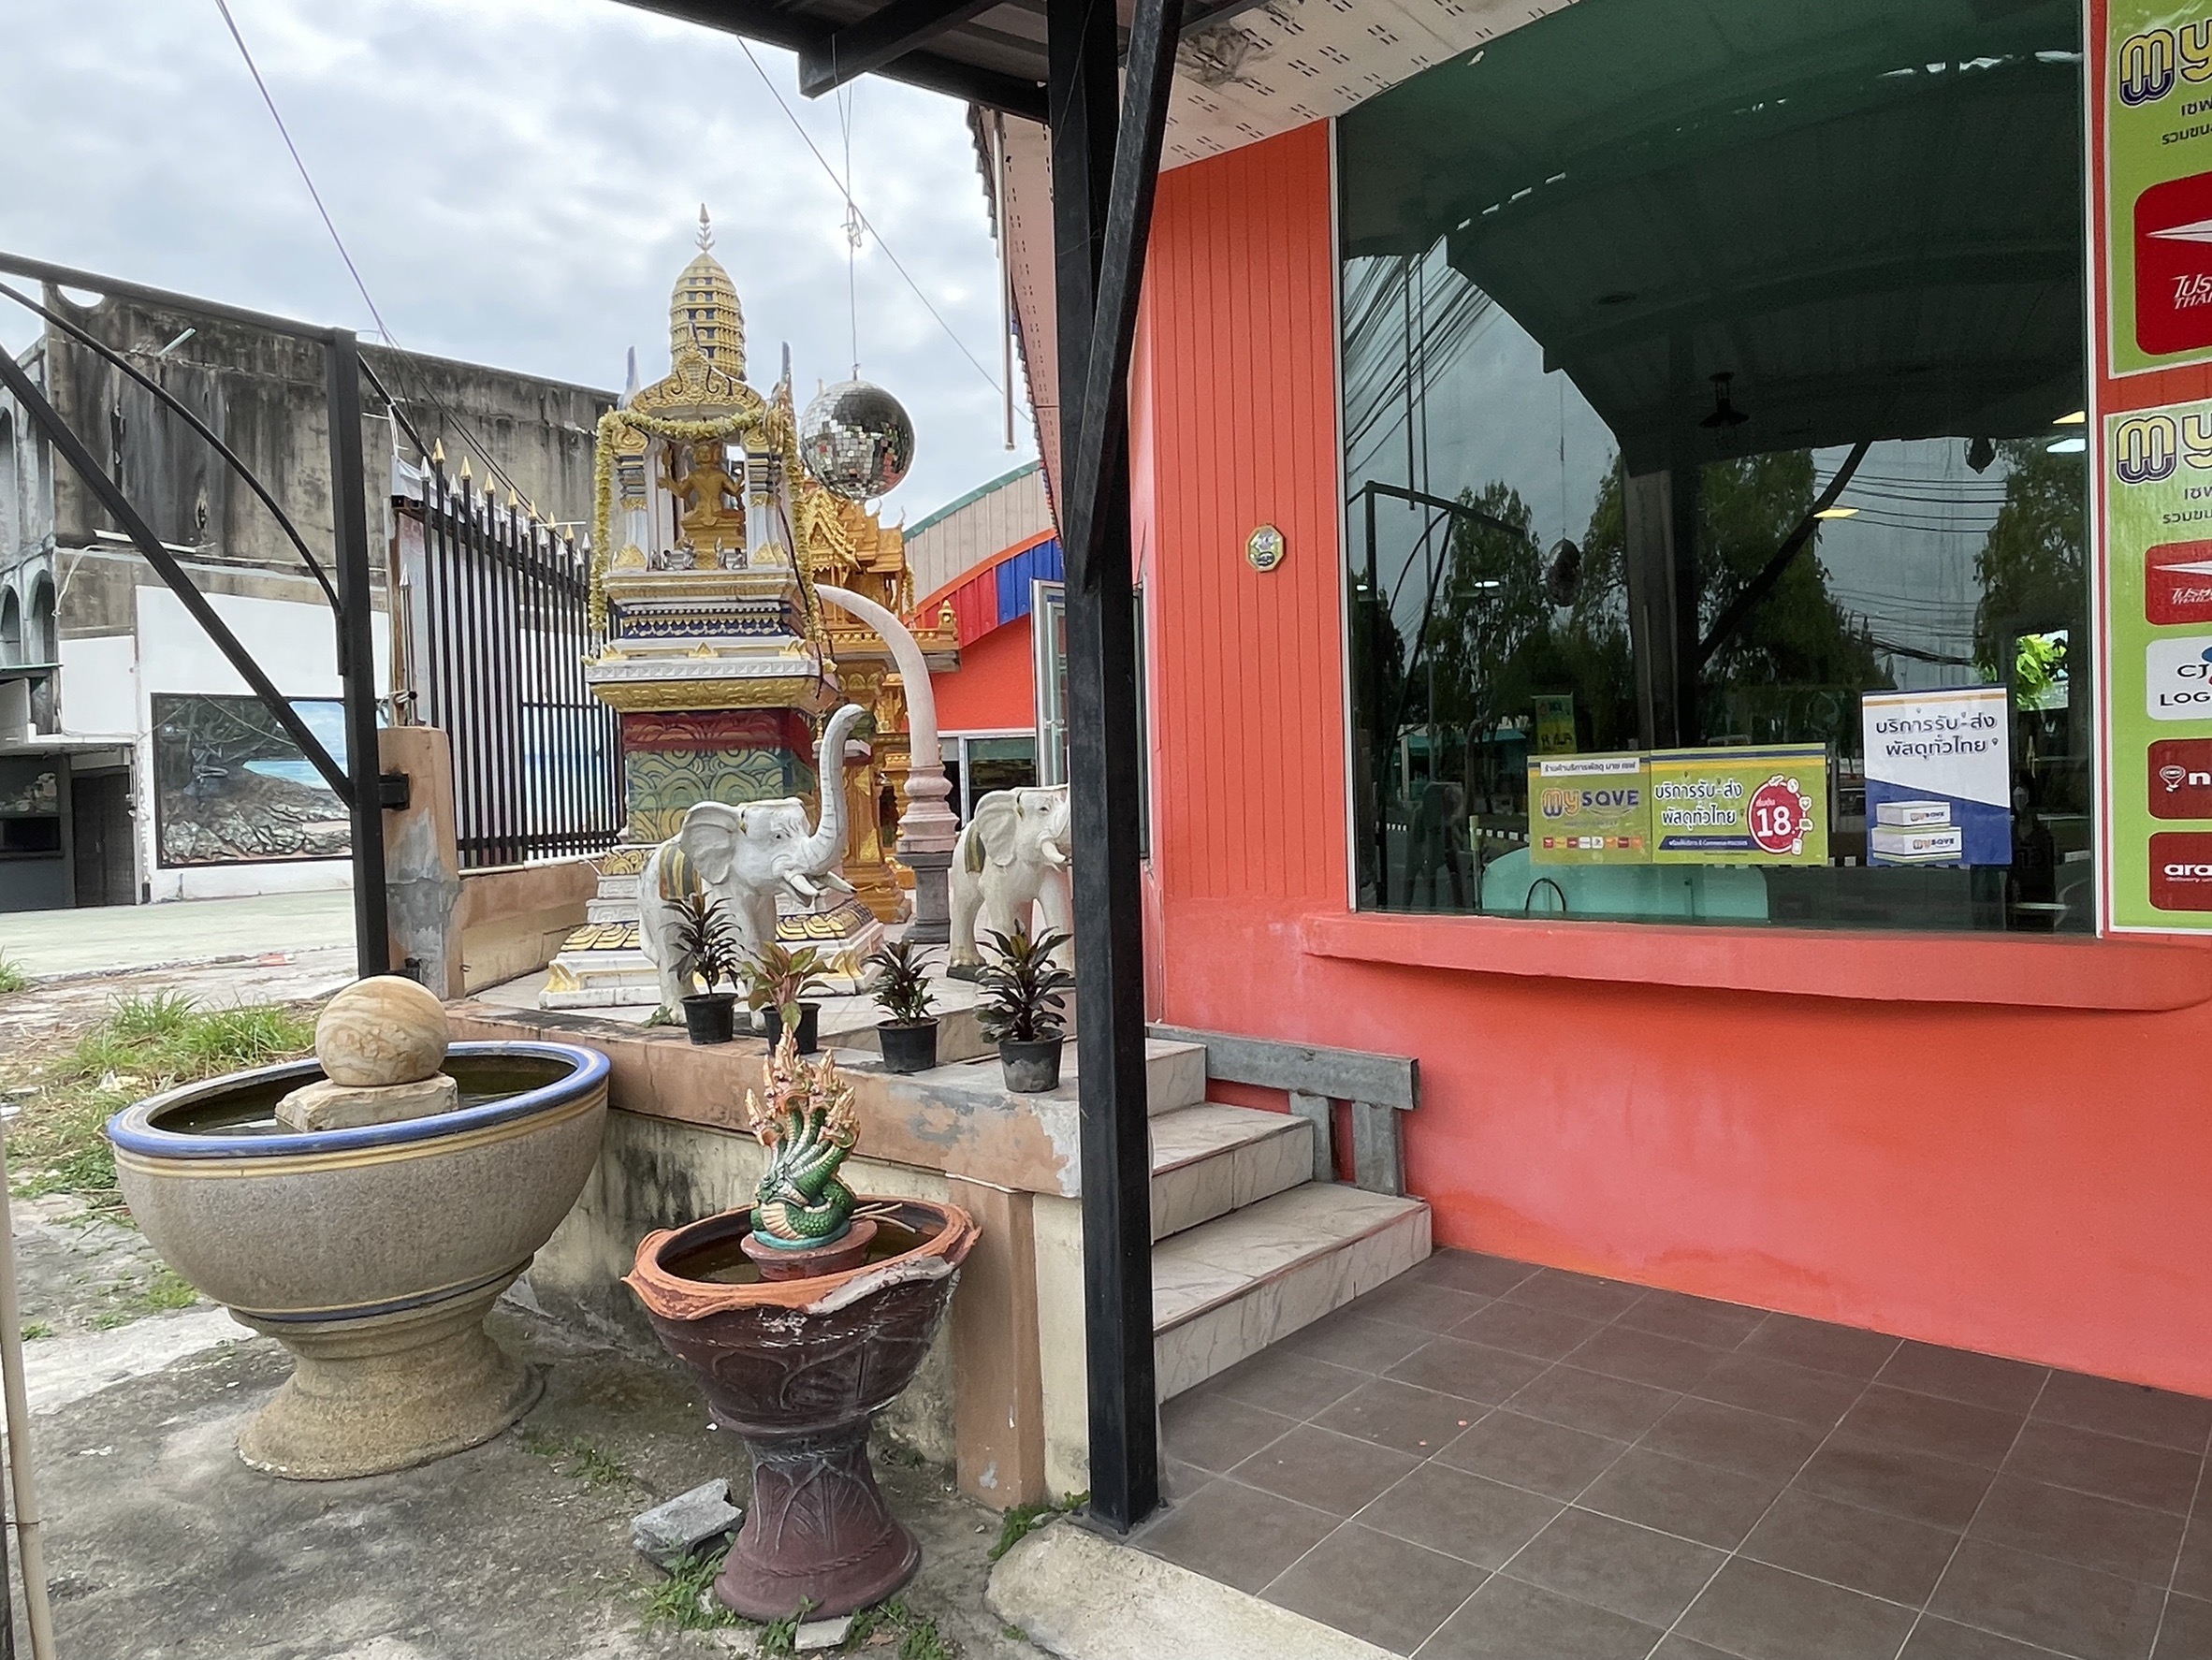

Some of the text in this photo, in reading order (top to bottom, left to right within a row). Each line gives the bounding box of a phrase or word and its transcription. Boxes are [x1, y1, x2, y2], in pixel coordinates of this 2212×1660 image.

[2162, 124, 2212, 145] รวมขน
[2176, 663, 2210, 679] CJ
[2160, 692, 2211, 706] LOG
[1885, 735, 1986, 759] พัสดุทั่วไทย
[1662, 802, 1737, 830] พัสดุทั่วไทย
